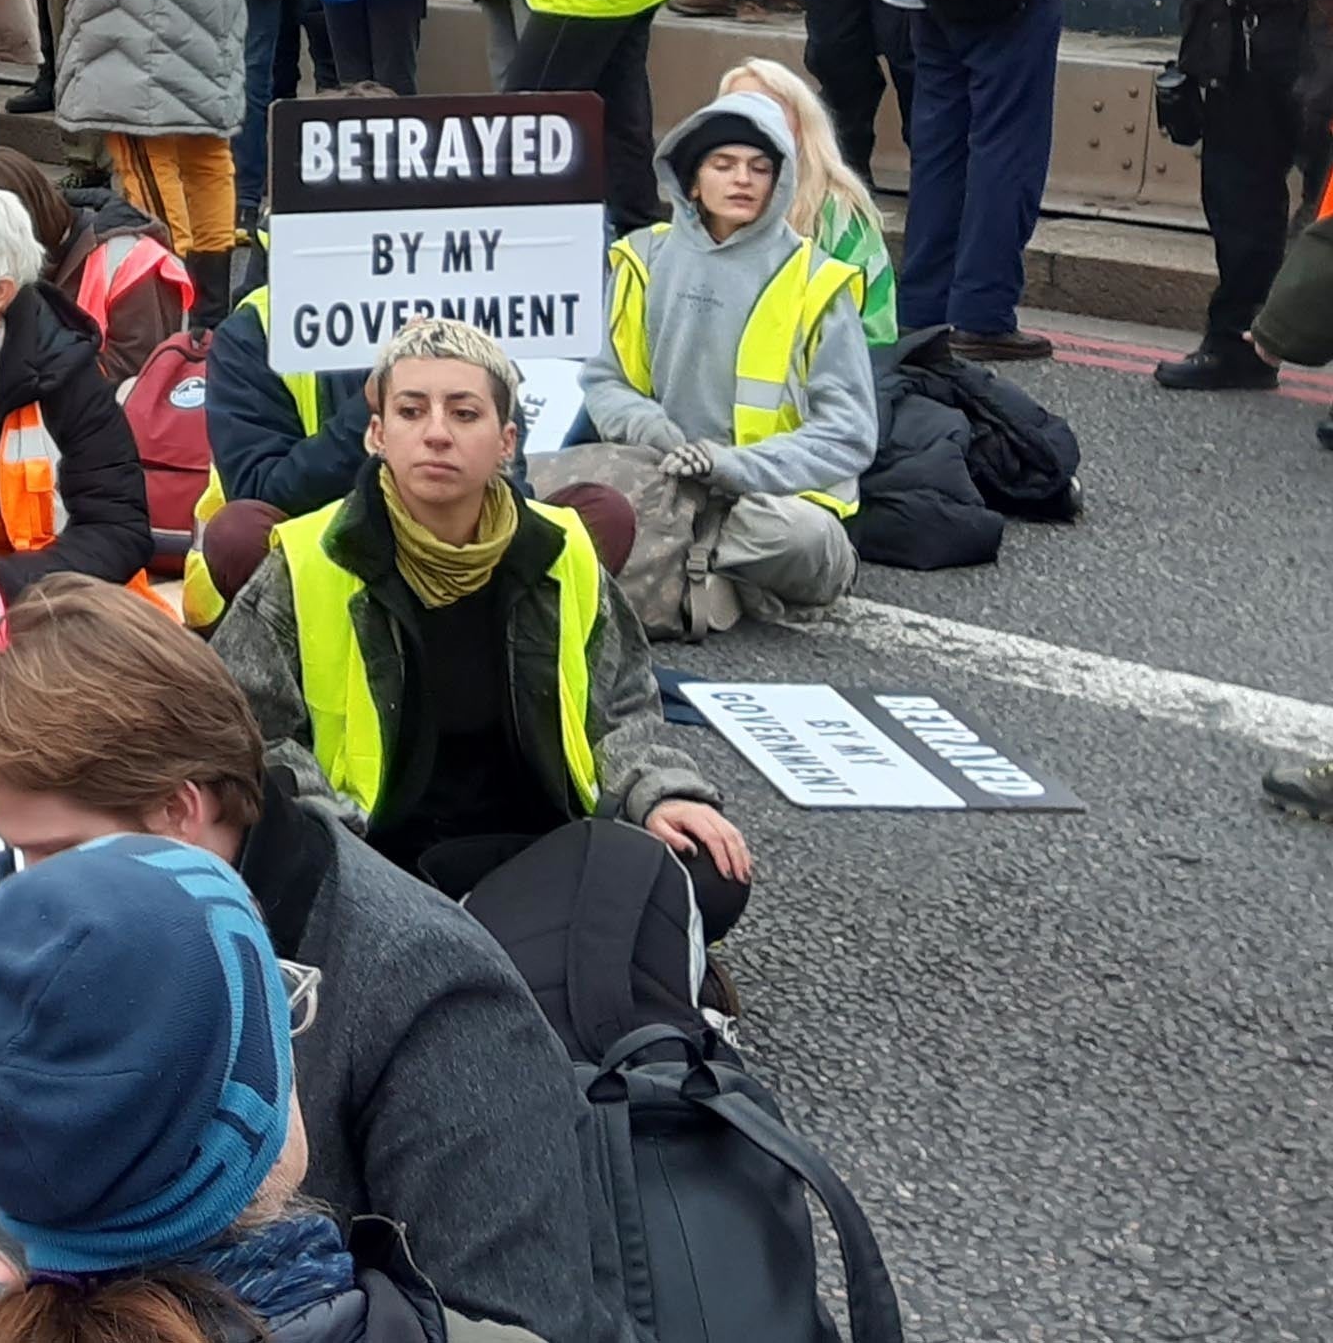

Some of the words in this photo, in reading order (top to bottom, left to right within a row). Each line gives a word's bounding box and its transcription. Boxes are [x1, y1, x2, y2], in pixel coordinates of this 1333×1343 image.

[301, 114, 574, 182] BETRAYED
[371, 231, 425, 276] BY
[441, 228, 503, 273] MY
[710, 691, 859, 798] GOVERNMENT
[804, 719, 865, 740] BY
[831, 743, 898, 769] MY
[873, 694, 1046, 798] BETRAYED
